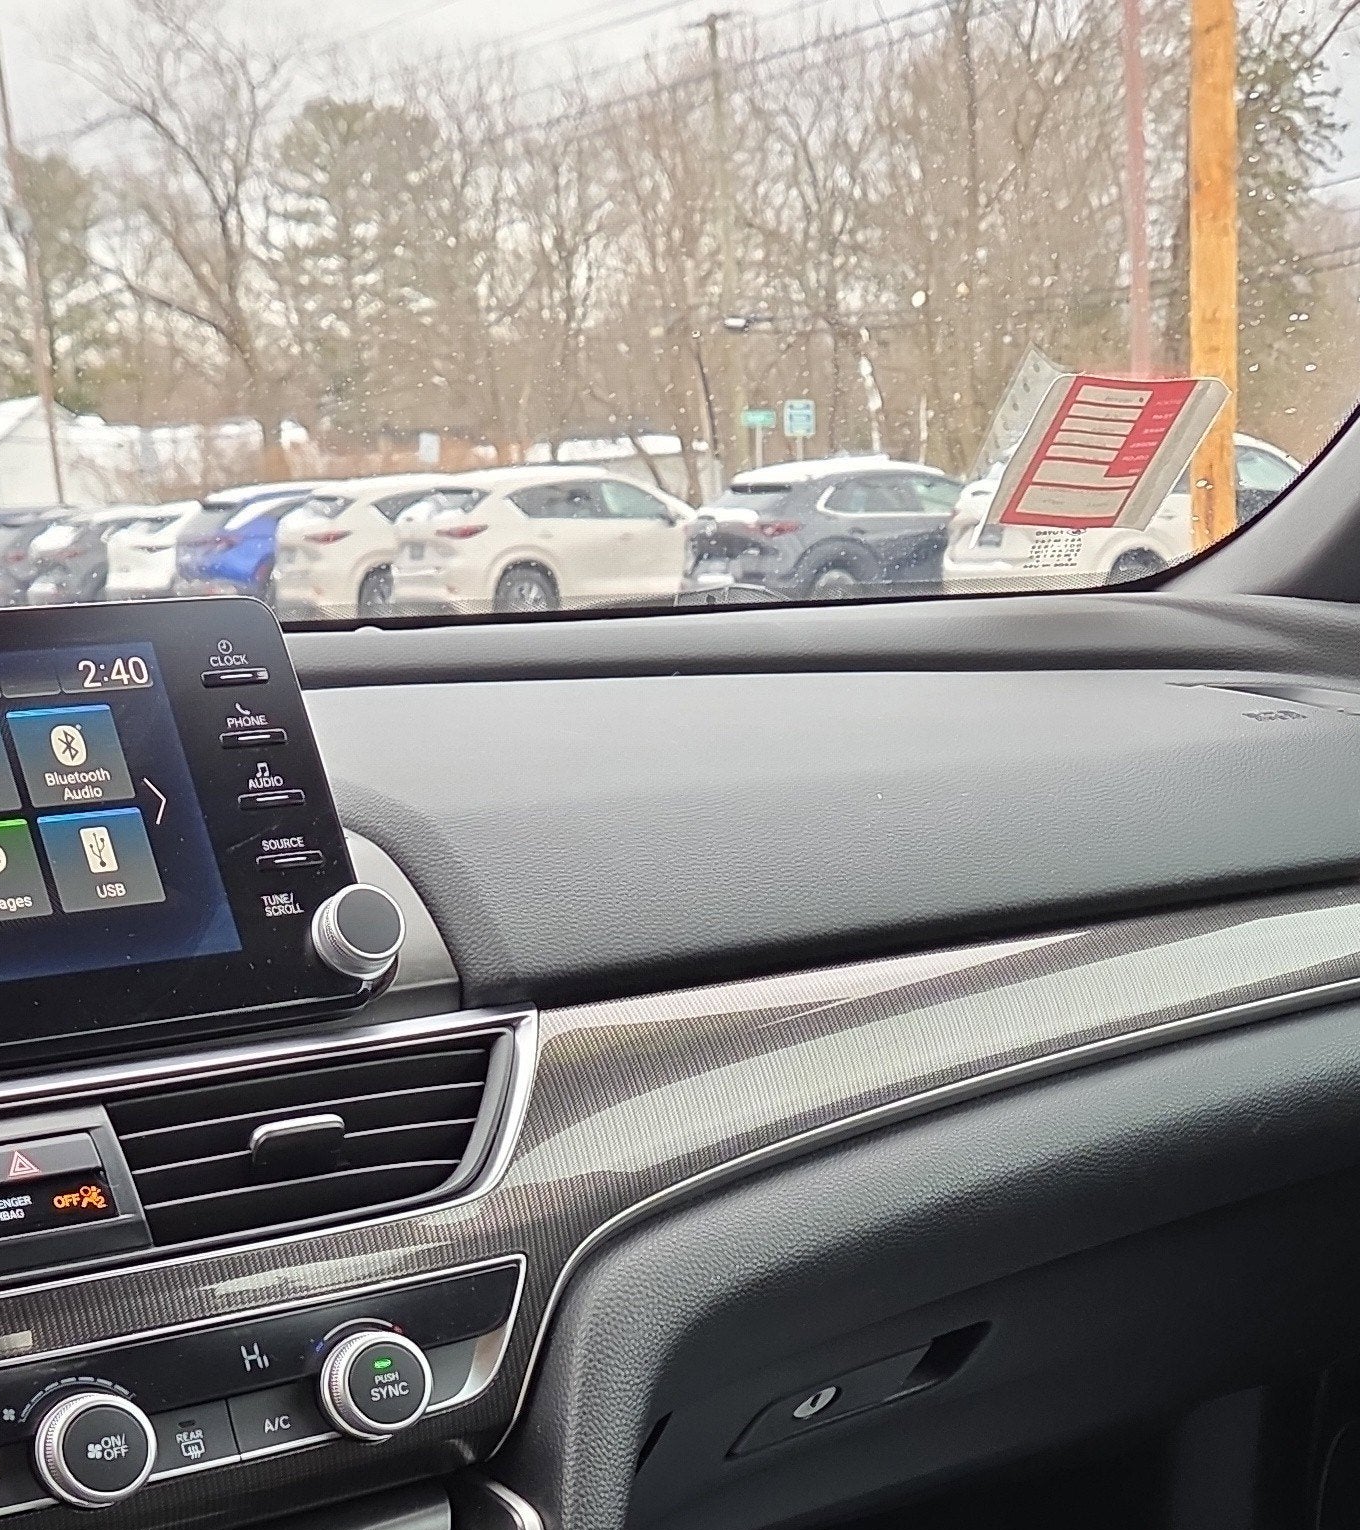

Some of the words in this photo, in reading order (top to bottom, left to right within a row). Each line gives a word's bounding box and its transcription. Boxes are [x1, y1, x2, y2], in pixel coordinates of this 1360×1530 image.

[209, 654, 249, 667] CLOCK
[77, 656, 150, 688] 2:40
[226, 714, 269, 729] PHONE
[45, 768, 111, 787] Bluetooth
[248, 776, 283, 790] AUDIO
[63, 785, 103, 801] Audio
[261, 836, 305, 851] SOURCE
[95, 882, 127, 899] USB
[264, 902, 305, 917] SCROLL
[53, 1193, 80, 1209] OFF
[374, 1371, 400, 1385] PUSH
[370, 1381, 409, 1402] SYNC
[264, 1415, 291, 1434] A/C
[100, 1433, 126, 1449] ON/
[176, 1429, 203, 1443] REAR
[102, 1444, 129, 1461] OFF
